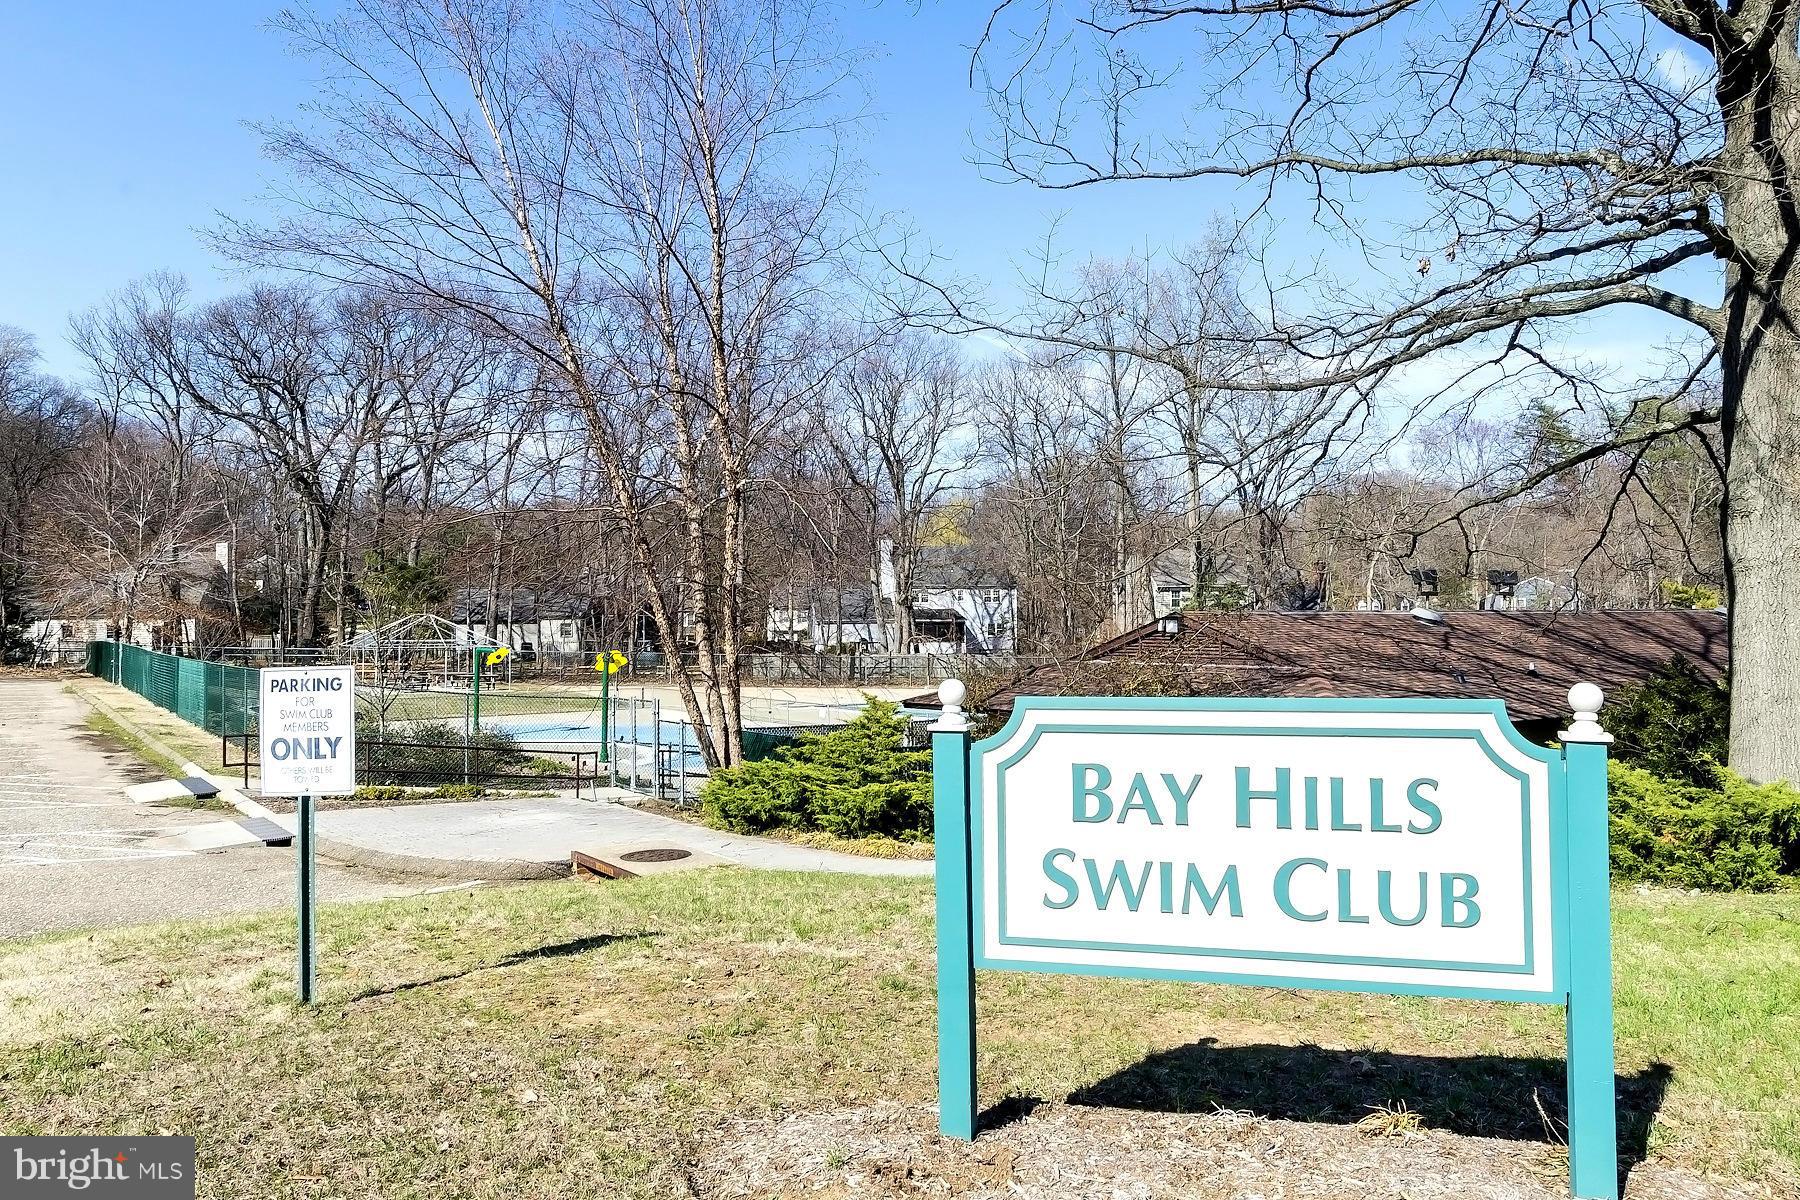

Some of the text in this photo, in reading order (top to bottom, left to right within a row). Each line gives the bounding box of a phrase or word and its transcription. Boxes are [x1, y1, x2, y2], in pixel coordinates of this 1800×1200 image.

[270, 677, 343, 692] PARKING
[295, 696, 315, 707] FOR
[279, 708, 333, 720] SWIM CLUB
[283, 721, 329, 732] MEMBERS
[270, 737, 343, 761] ONLY
[1071, 762, 1443, 835] BAY HILLS
[1042, 847, 1482, 929] SWIM CLUB
